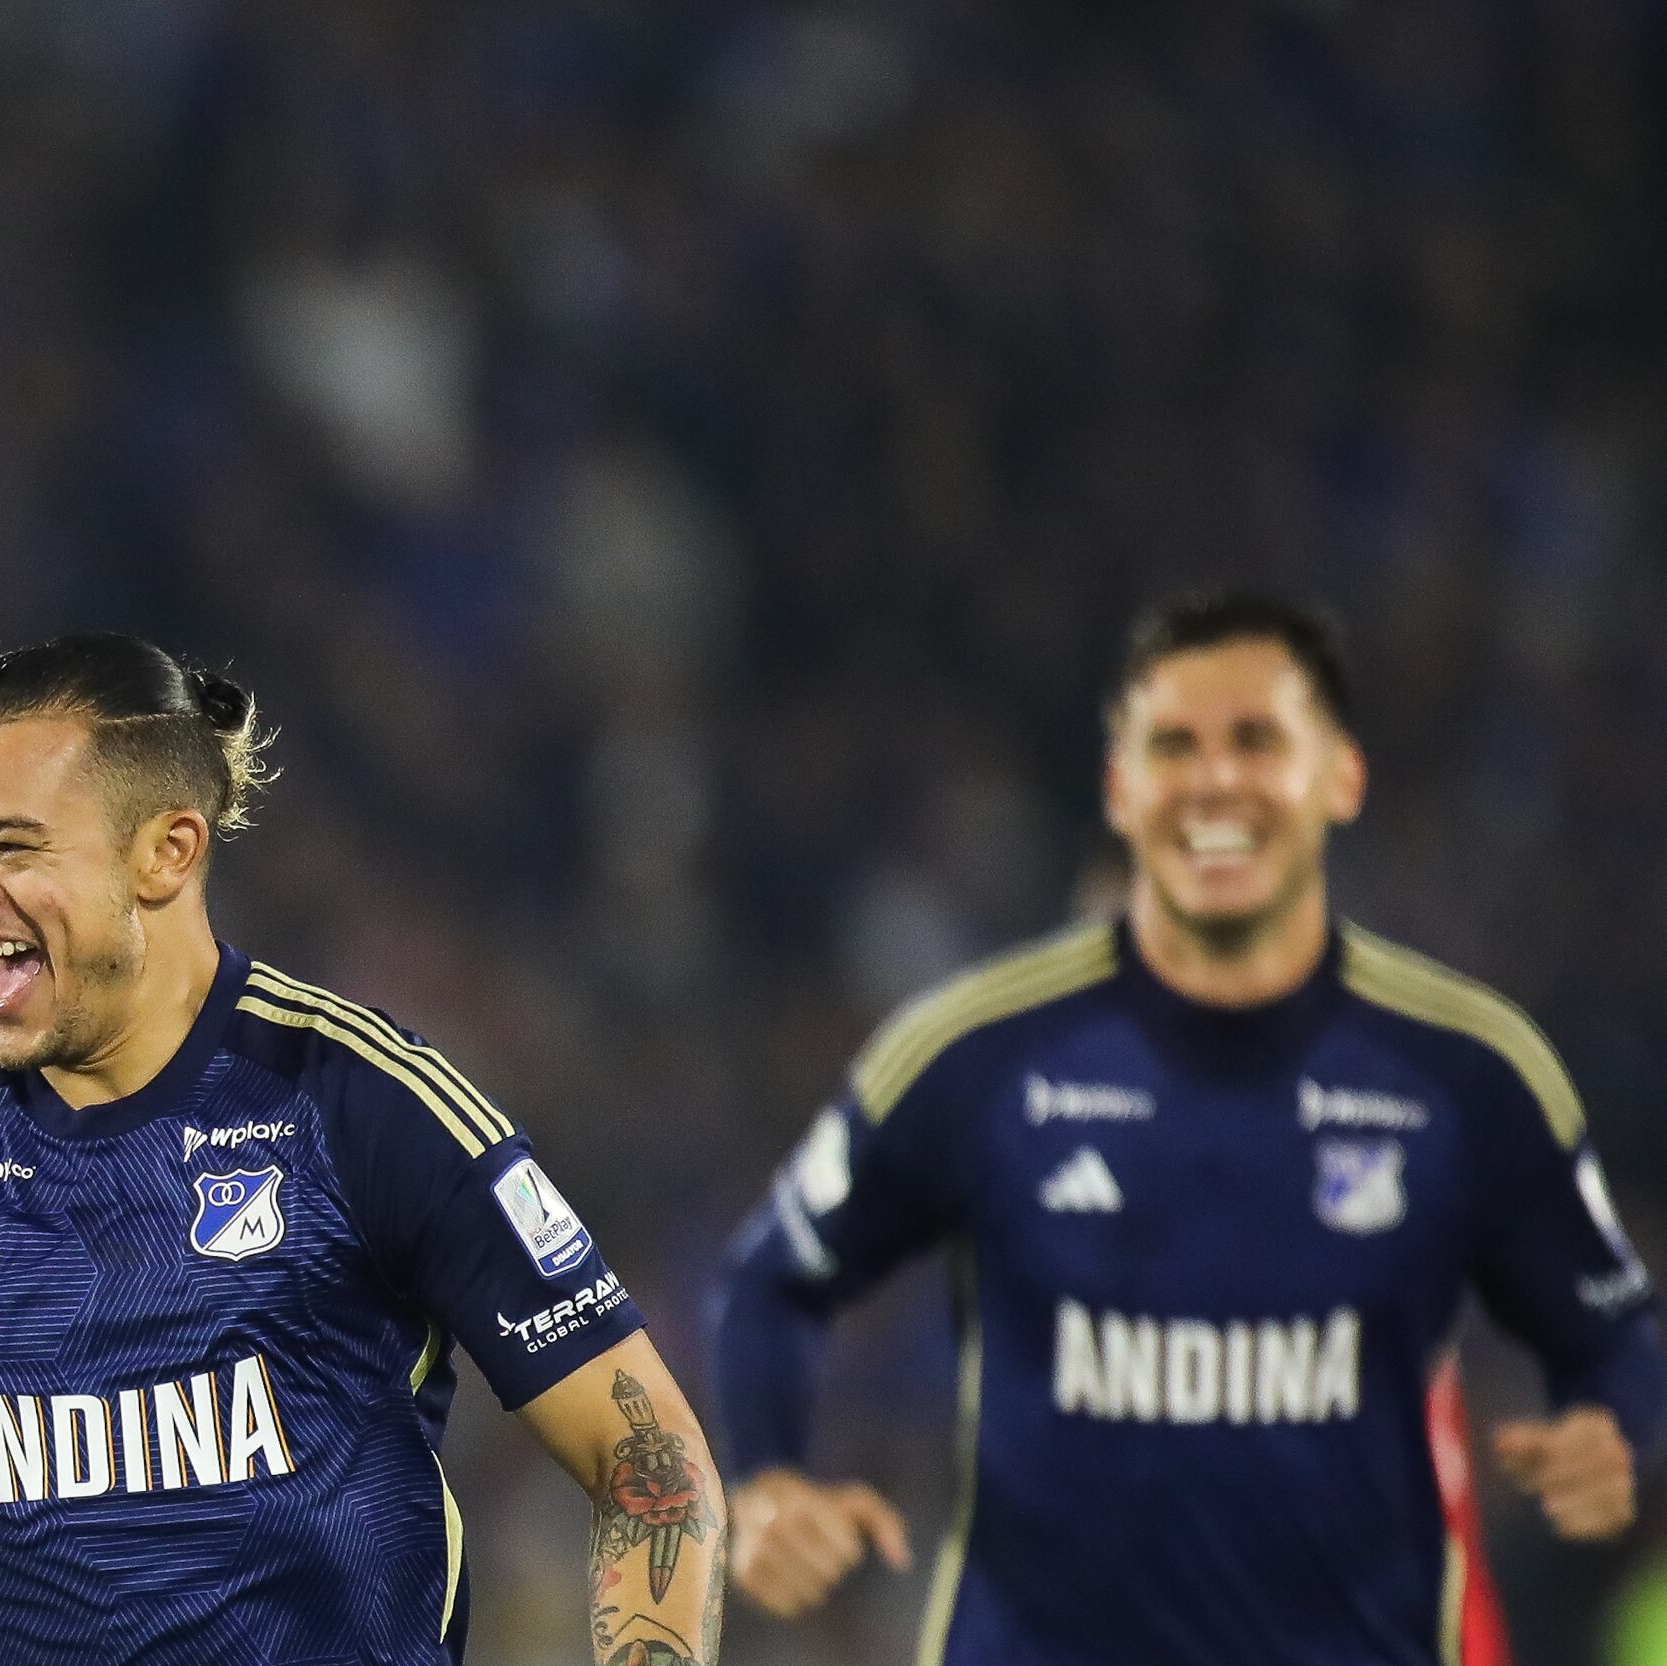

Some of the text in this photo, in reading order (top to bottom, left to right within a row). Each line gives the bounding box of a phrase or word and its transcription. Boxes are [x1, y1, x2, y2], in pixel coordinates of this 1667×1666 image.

[534, 1216, 573, 1250] BetPlay
[527, 1314, 589, 1354] GLOBAL
[1052, 1295, 1360, 1424] ANDINA
